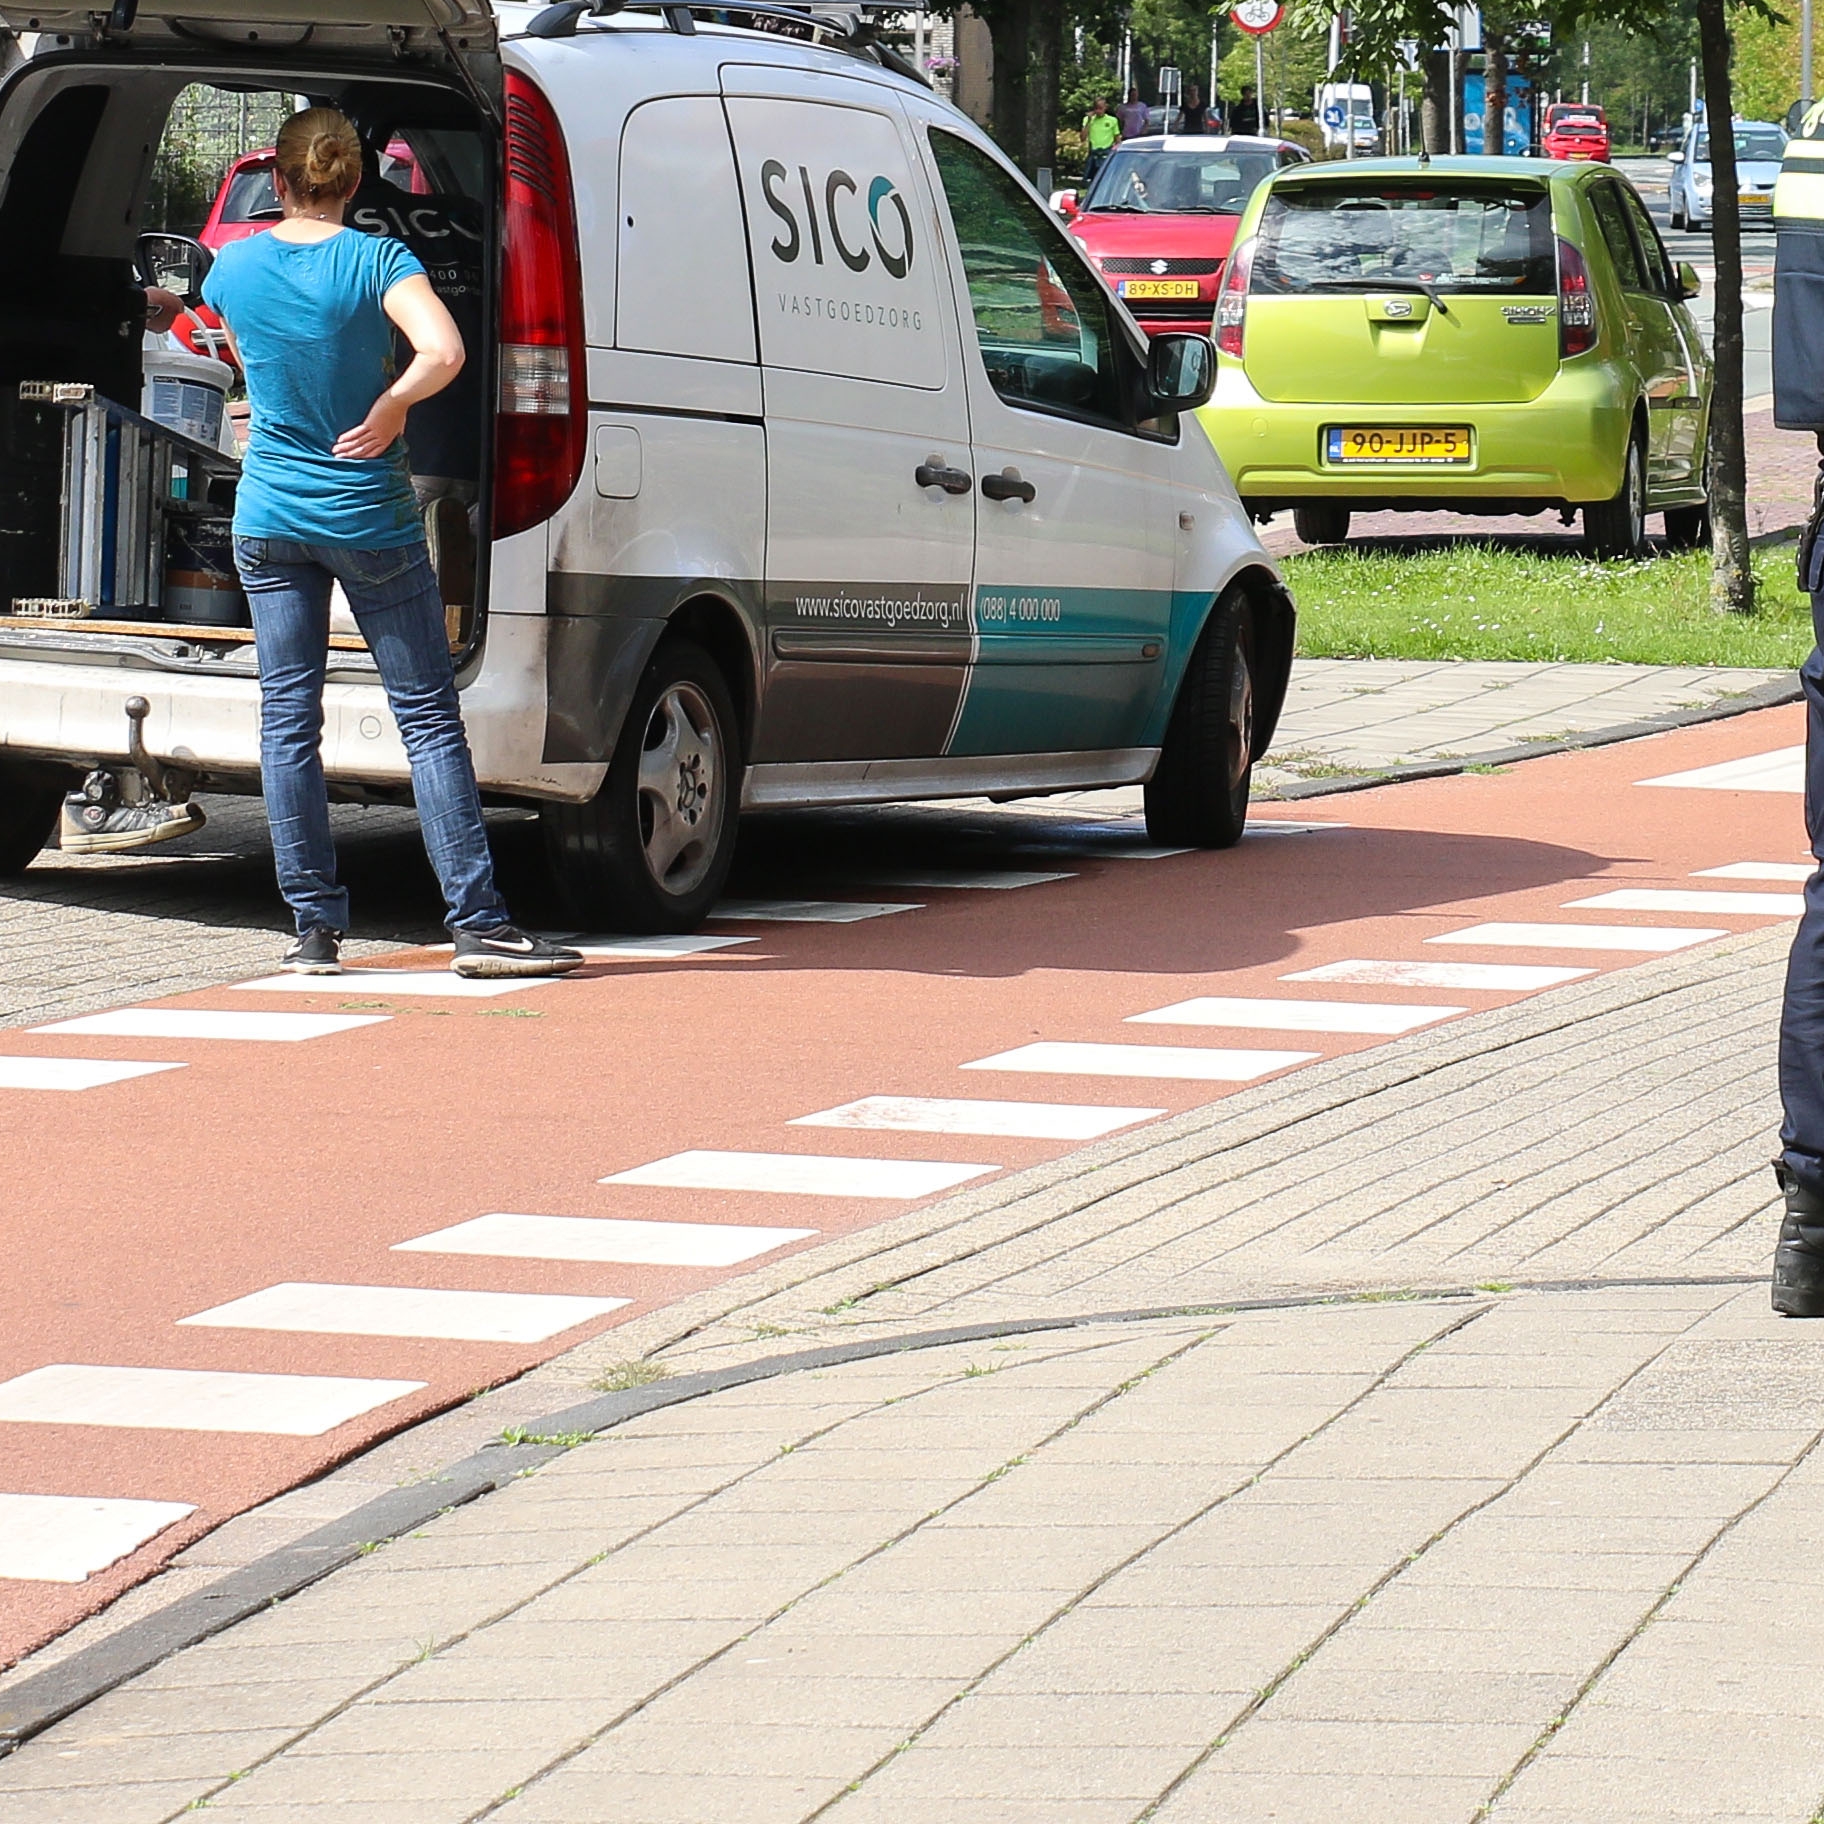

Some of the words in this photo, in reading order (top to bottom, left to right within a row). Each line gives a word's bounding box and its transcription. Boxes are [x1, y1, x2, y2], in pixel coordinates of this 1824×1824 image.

[761, 159, 914, 279] SICO
[1129, 283, 1194, 295] 89-XS-DH
[778, 293, 922, 330] VASTGOEDZORG
[1352, 432, 1457, 454] 90-JJP-5
[796, 590, 965, 628] www.sicovastgoedzorg.nl
[980, 596, 1007, 623] (088)
[1009, 597, 1017, 619] 4
[1018, 598, 1039, 621] 000
[1041, 598, 1061, 622] 000
